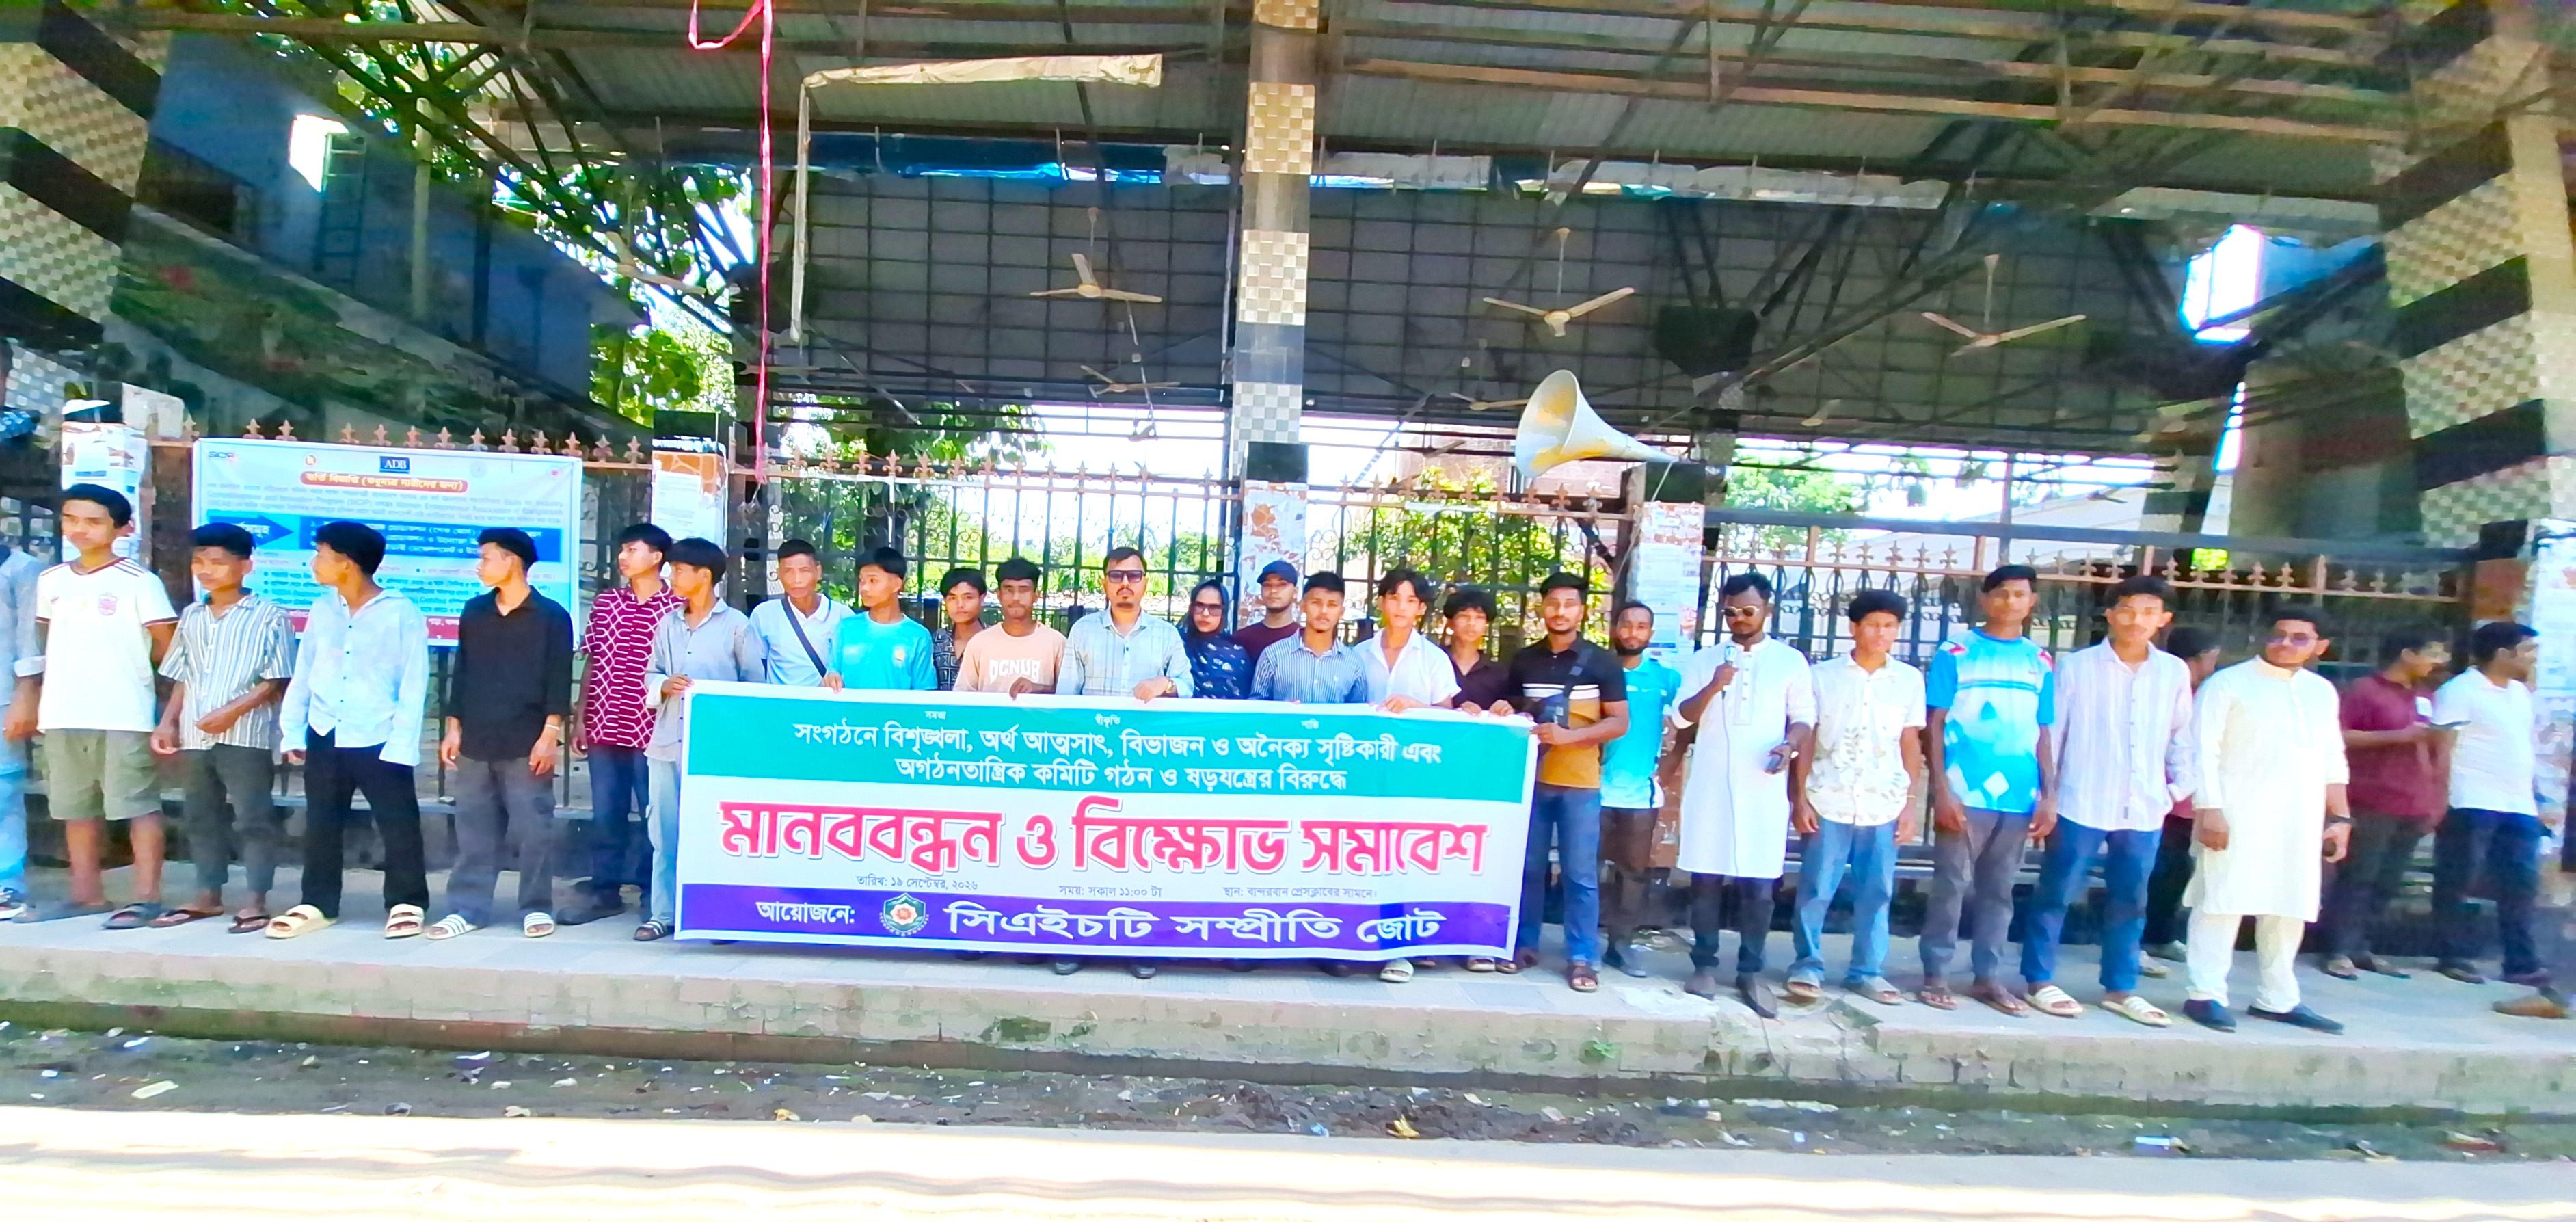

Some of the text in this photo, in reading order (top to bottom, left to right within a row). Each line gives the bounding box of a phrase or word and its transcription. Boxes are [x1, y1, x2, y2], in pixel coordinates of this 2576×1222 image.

[384, 459, 407, 469] ADB
[793, 717, 879, 747] সংগঠনে
[883, 720, 974, 756] বিশৃঙ্খলা,
[978, 723, 1020, 752] অর্থ
[1118, 728, 1207, 758] বিভাজন
[1211, 738, 1229, 756] ও
[1235, 731, 1312, 760] অনৈক্য
[1315, 732, 1399, 767] সৃষ্টিকারী
[1402, 743, 1443, 764] এবং
[894, 752, 1348, 793] অগঠনতান্ত্রিক কমিটি গঠন ও ষড়যন্ত্রের বিরুদ্ধে
[718, 795, 1490, 876] মানববন্ধন ও বিক্ষোভ সমাবেশ
[857, 873, 887, 887] তারিখ:
[891, 878, 903, 887] ১৯
[1059, 885, 1163, 897] সময়: সকাল ১১:০০ টা
[755, 900, 855, 925] আয়োজনে:
[943, 901, 1447, 943] সিএইচটি সম্প্রীতি জোট
